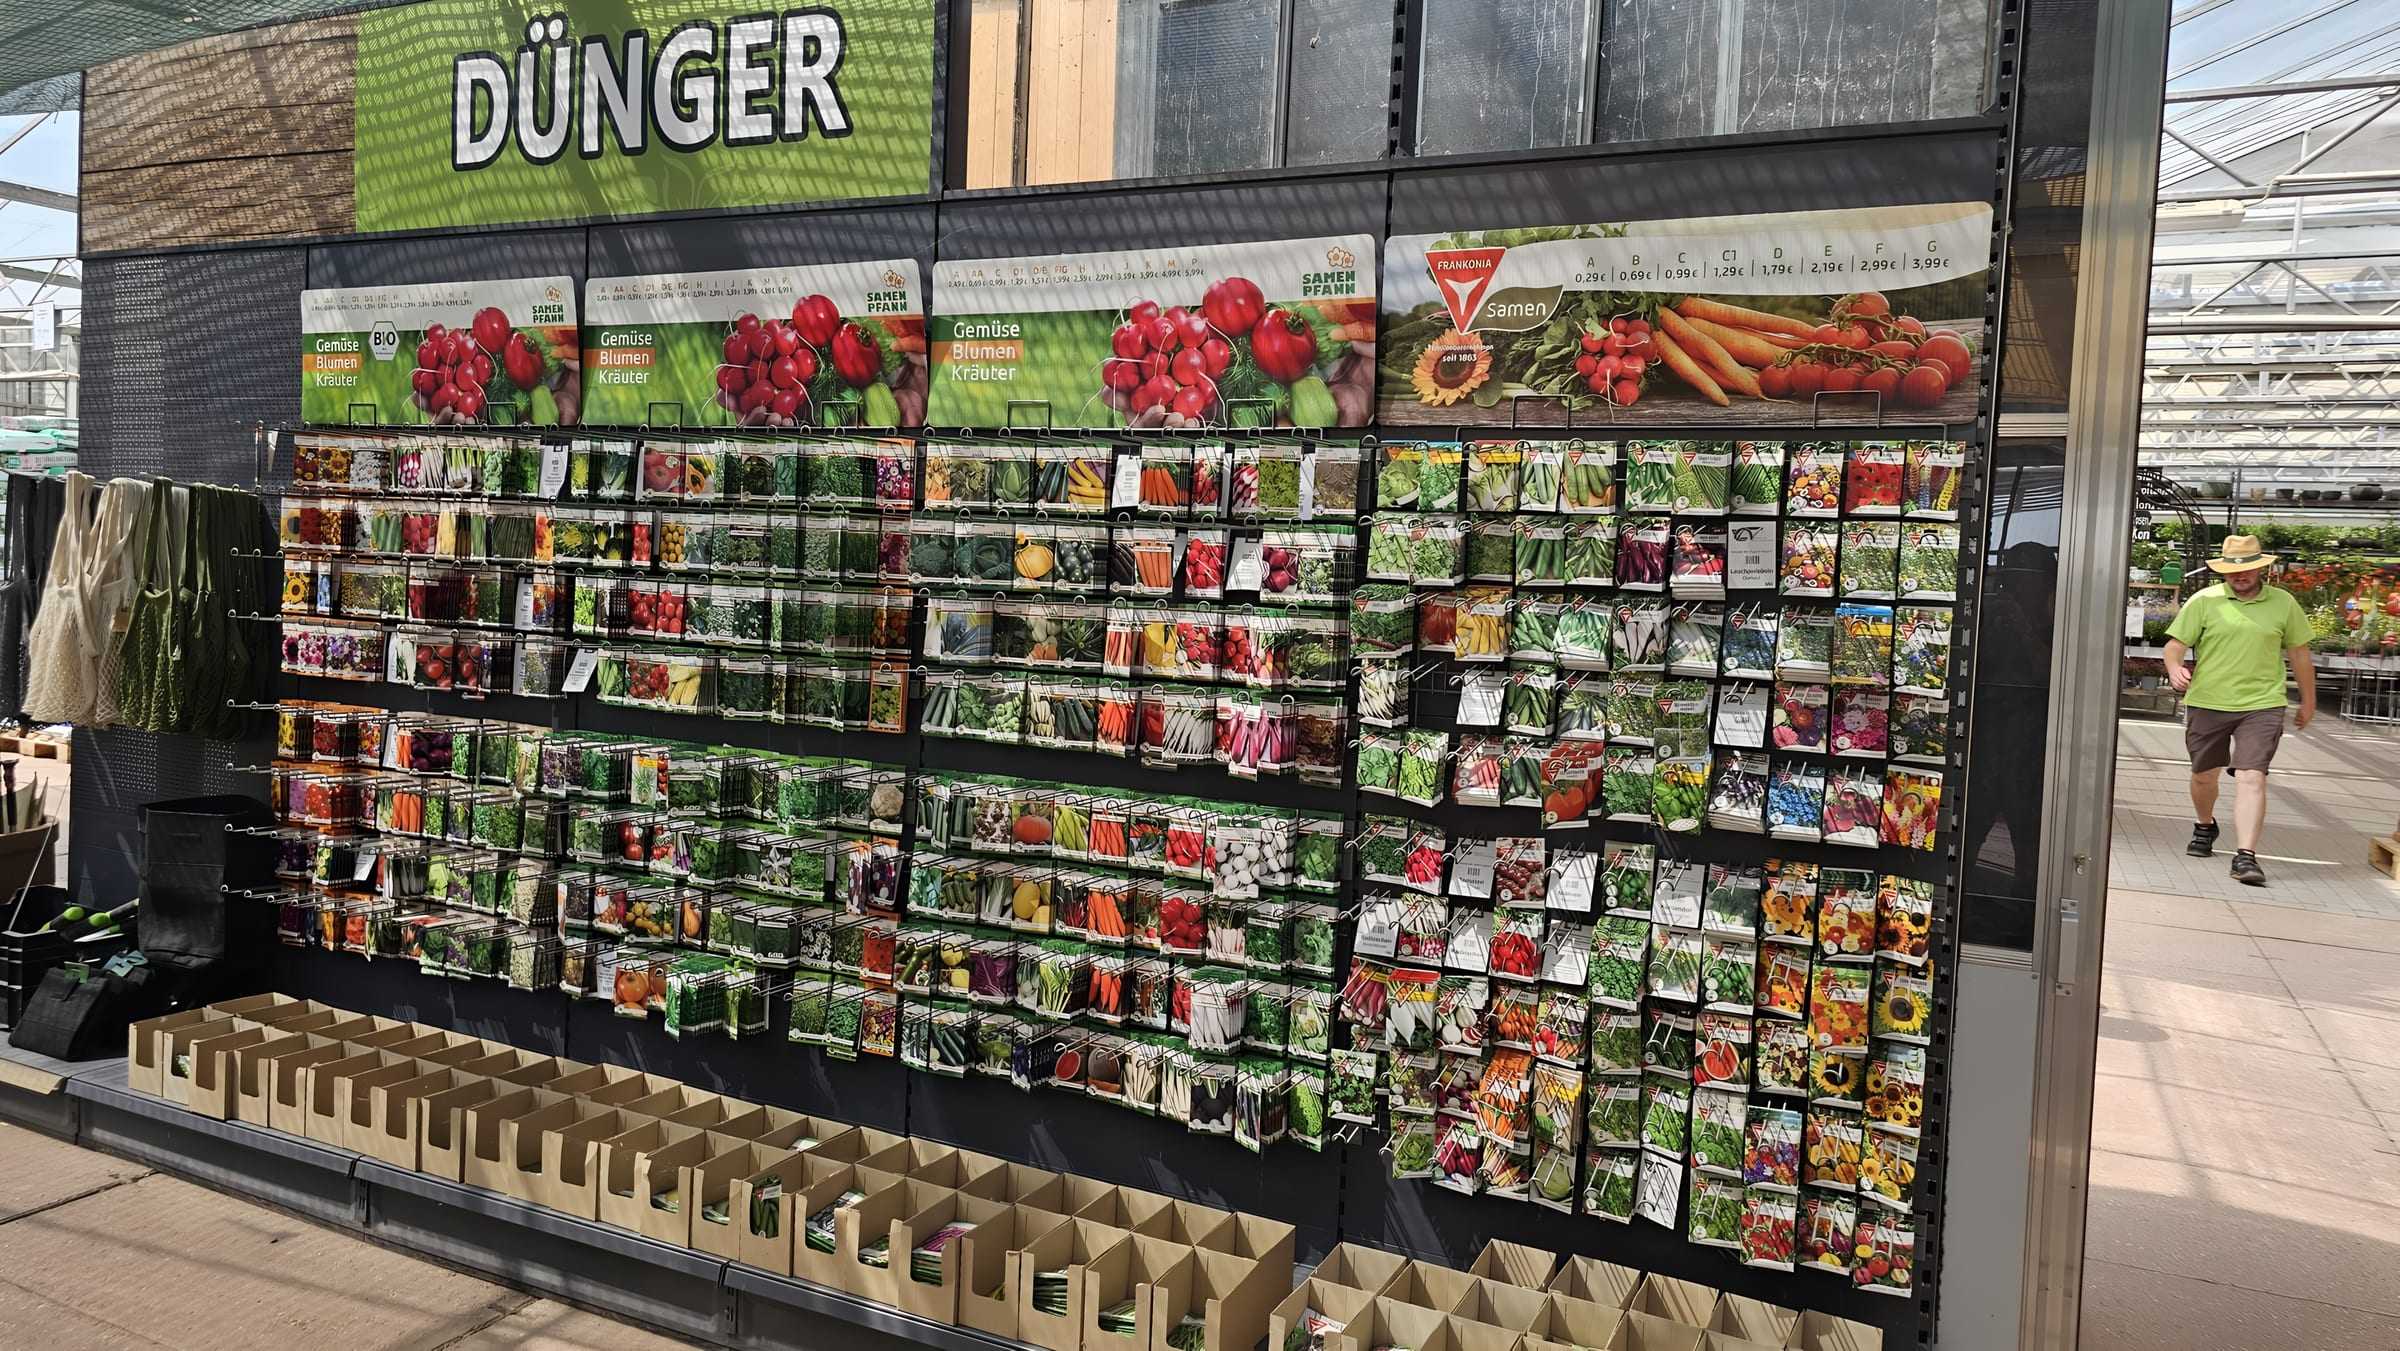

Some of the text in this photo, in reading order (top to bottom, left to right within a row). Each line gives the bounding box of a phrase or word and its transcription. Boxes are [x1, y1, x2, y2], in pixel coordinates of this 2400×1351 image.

[454, 11, 850, 168] DÜNGER
[1587, 241, 1937, 267] A B C C1 D E F G
[1437, 259, 1492, 271] FRANKONIA
[1302, 271, 1356, 284] SAMEN
[866, 290, 907, 302] SAMEN
[1302, 283, 1356, 297] PFANN
[531, 304, 564, 314] SAMEN
[867, 301, 907, 313] PFANN
[1487, 302, 1547, 318] Samen
[532, 313, 564, 324] PFANN
[953, 321, 1020, 339] Gemüse
[316, 338, 359, 353] Gemüse
[374, 331, 396, 346] BIO
[600, 331, 652, 346] Gemüse
[599, 351, 649, 365] Blumen
[952, 343, 1016, 360] Blumen
[1442, 354, 1456, 362] seit
[316, 355, 357, 369] Blumen
[316, 373, 357, 387] Kräuter
[599, 369, 649, 384] Kräuter
[951, 365, 1016, 382] Kräuter
